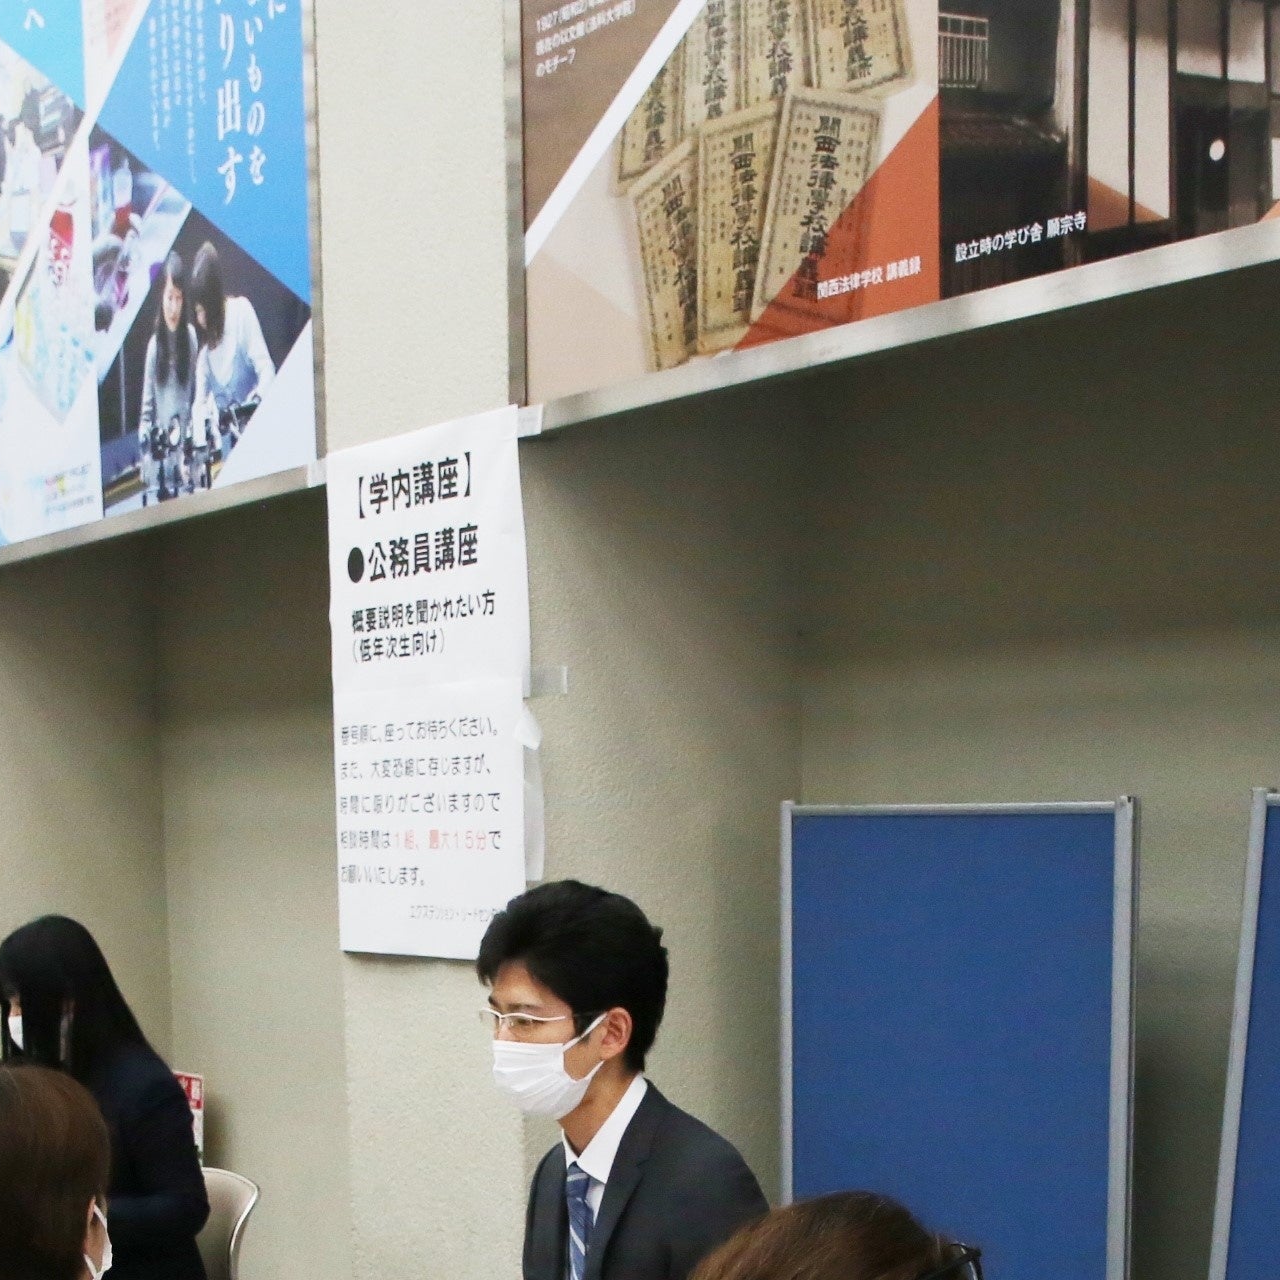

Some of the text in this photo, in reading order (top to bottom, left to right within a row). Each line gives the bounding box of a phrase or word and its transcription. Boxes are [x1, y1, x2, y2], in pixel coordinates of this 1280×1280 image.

[217, 0, 245, 205] り出す
[243, 0, 268, 187] いものを
[955, 221, 1044, 263] 設立時の学び舎
[816, 266, 883, 301] 関西法律学校
[357, 451, 472, 519] 【学内講座】
